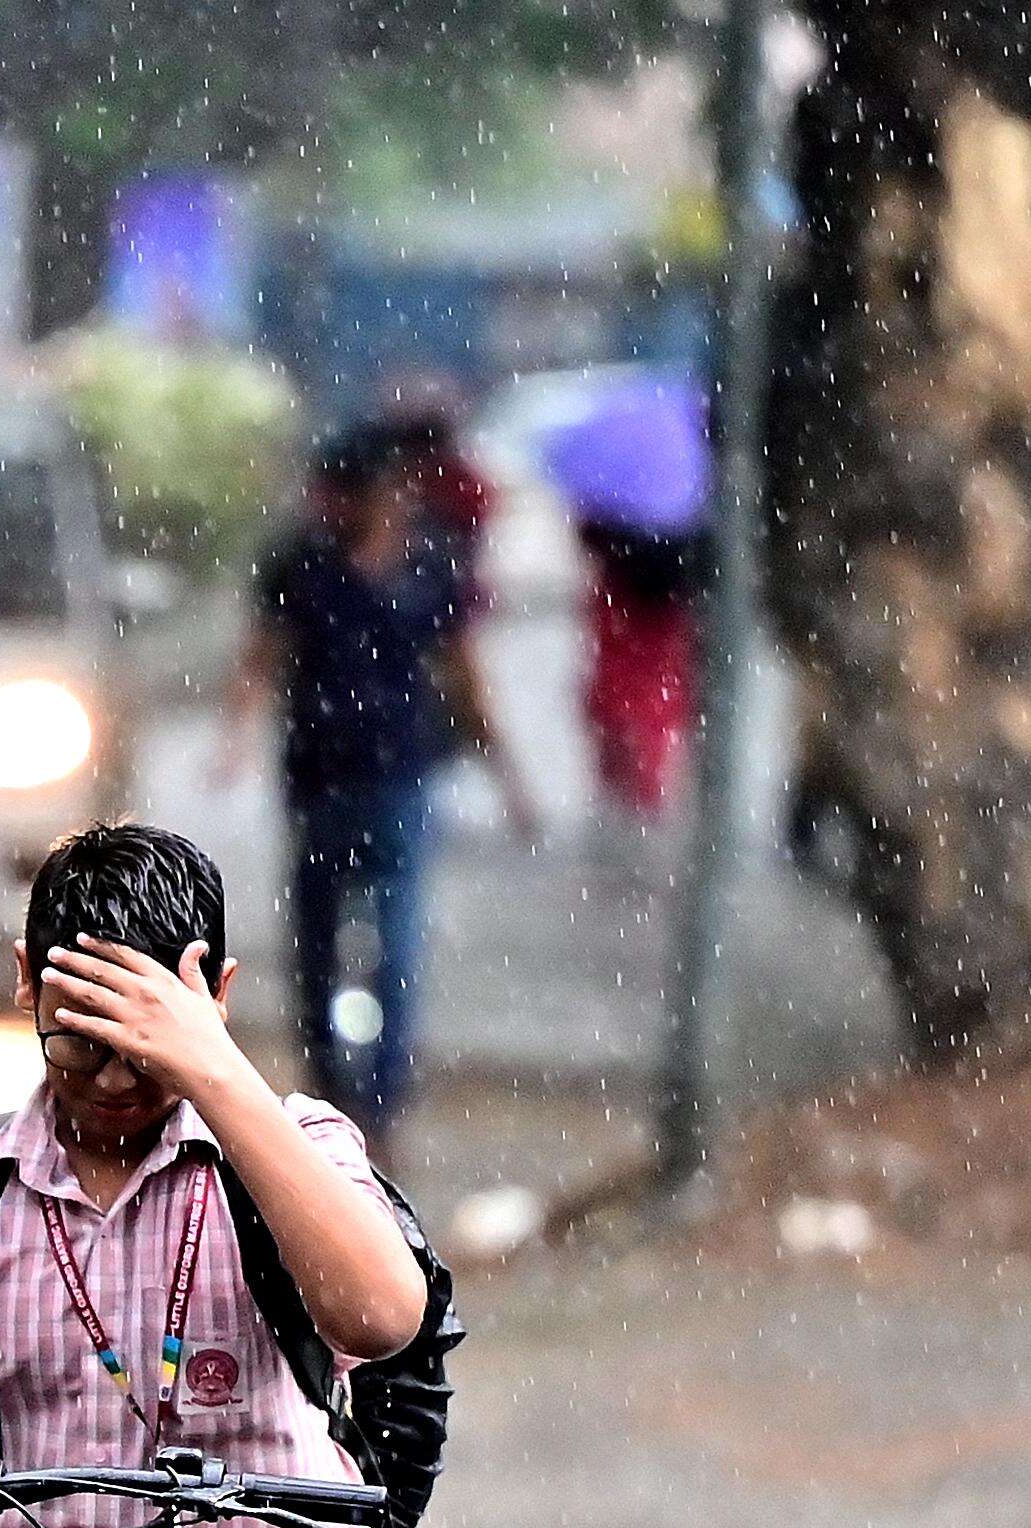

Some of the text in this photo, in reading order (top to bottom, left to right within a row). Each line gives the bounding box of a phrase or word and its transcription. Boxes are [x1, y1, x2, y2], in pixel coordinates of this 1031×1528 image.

[63, 1263, 87, 1308] OXFORD
[177, 1243, 196, 1291] OXFORD
[81, 1308, 103, 1344] LITTLE
[169, 1290, 186, 1330] LITTLE
